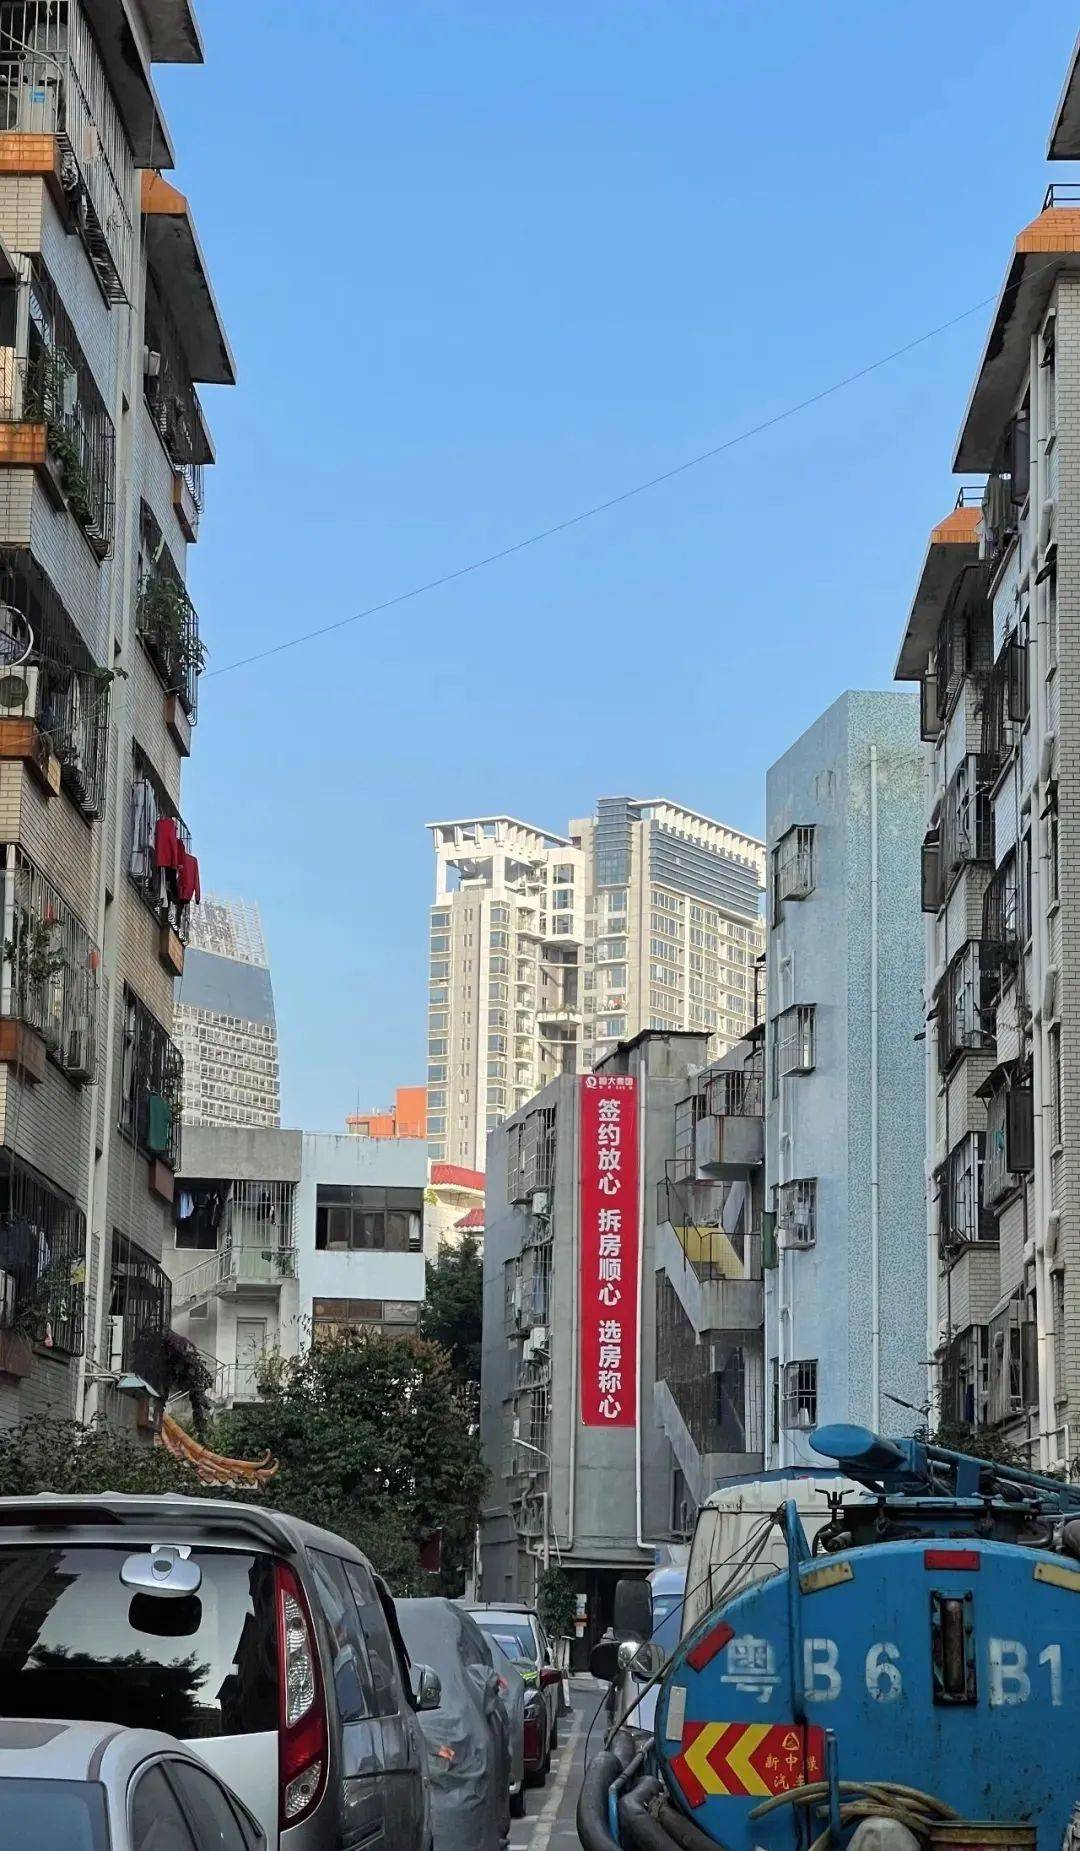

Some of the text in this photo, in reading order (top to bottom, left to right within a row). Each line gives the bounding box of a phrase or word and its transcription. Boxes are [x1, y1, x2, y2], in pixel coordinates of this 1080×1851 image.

[598, 1098, 621, 1195] 签约放心
[598, 1208, 622, 1306] 拆房顺心
[598, 1319, 622, 1420] 选房称心
